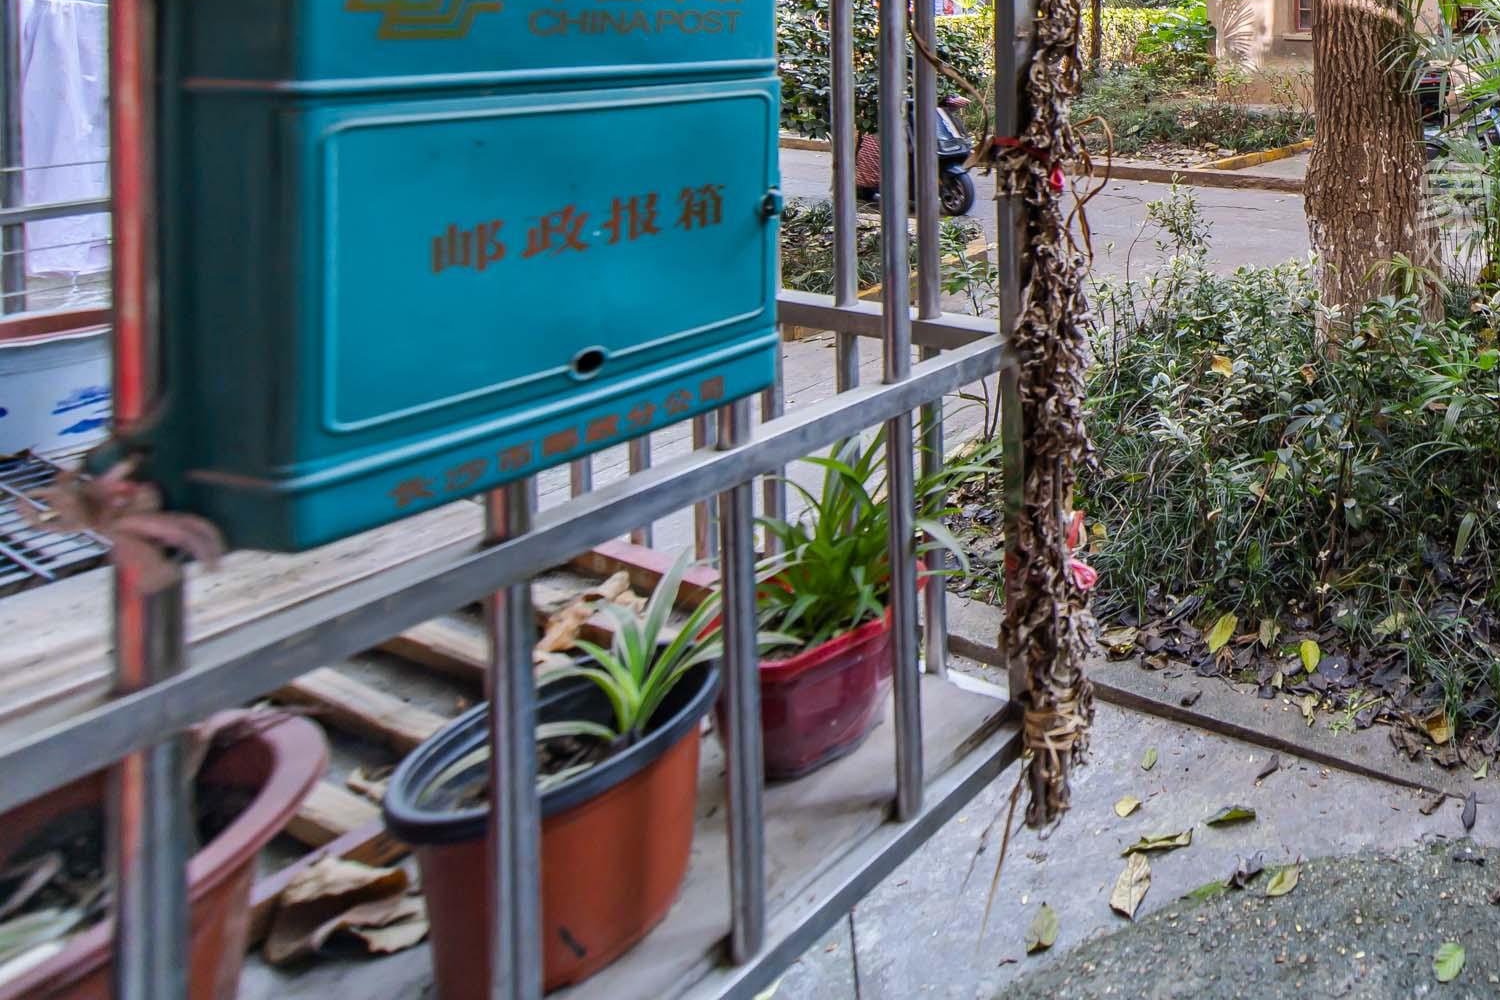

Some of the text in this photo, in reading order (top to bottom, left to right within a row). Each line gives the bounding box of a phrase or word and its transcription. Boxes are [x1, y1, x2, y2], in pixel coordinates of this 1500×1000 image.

[528, 7, 742, 37] CHINA POST
[430, 183, 725, 275] 邮政报箱
[388, 375, 725, 508] 长沙市邮政分公司
